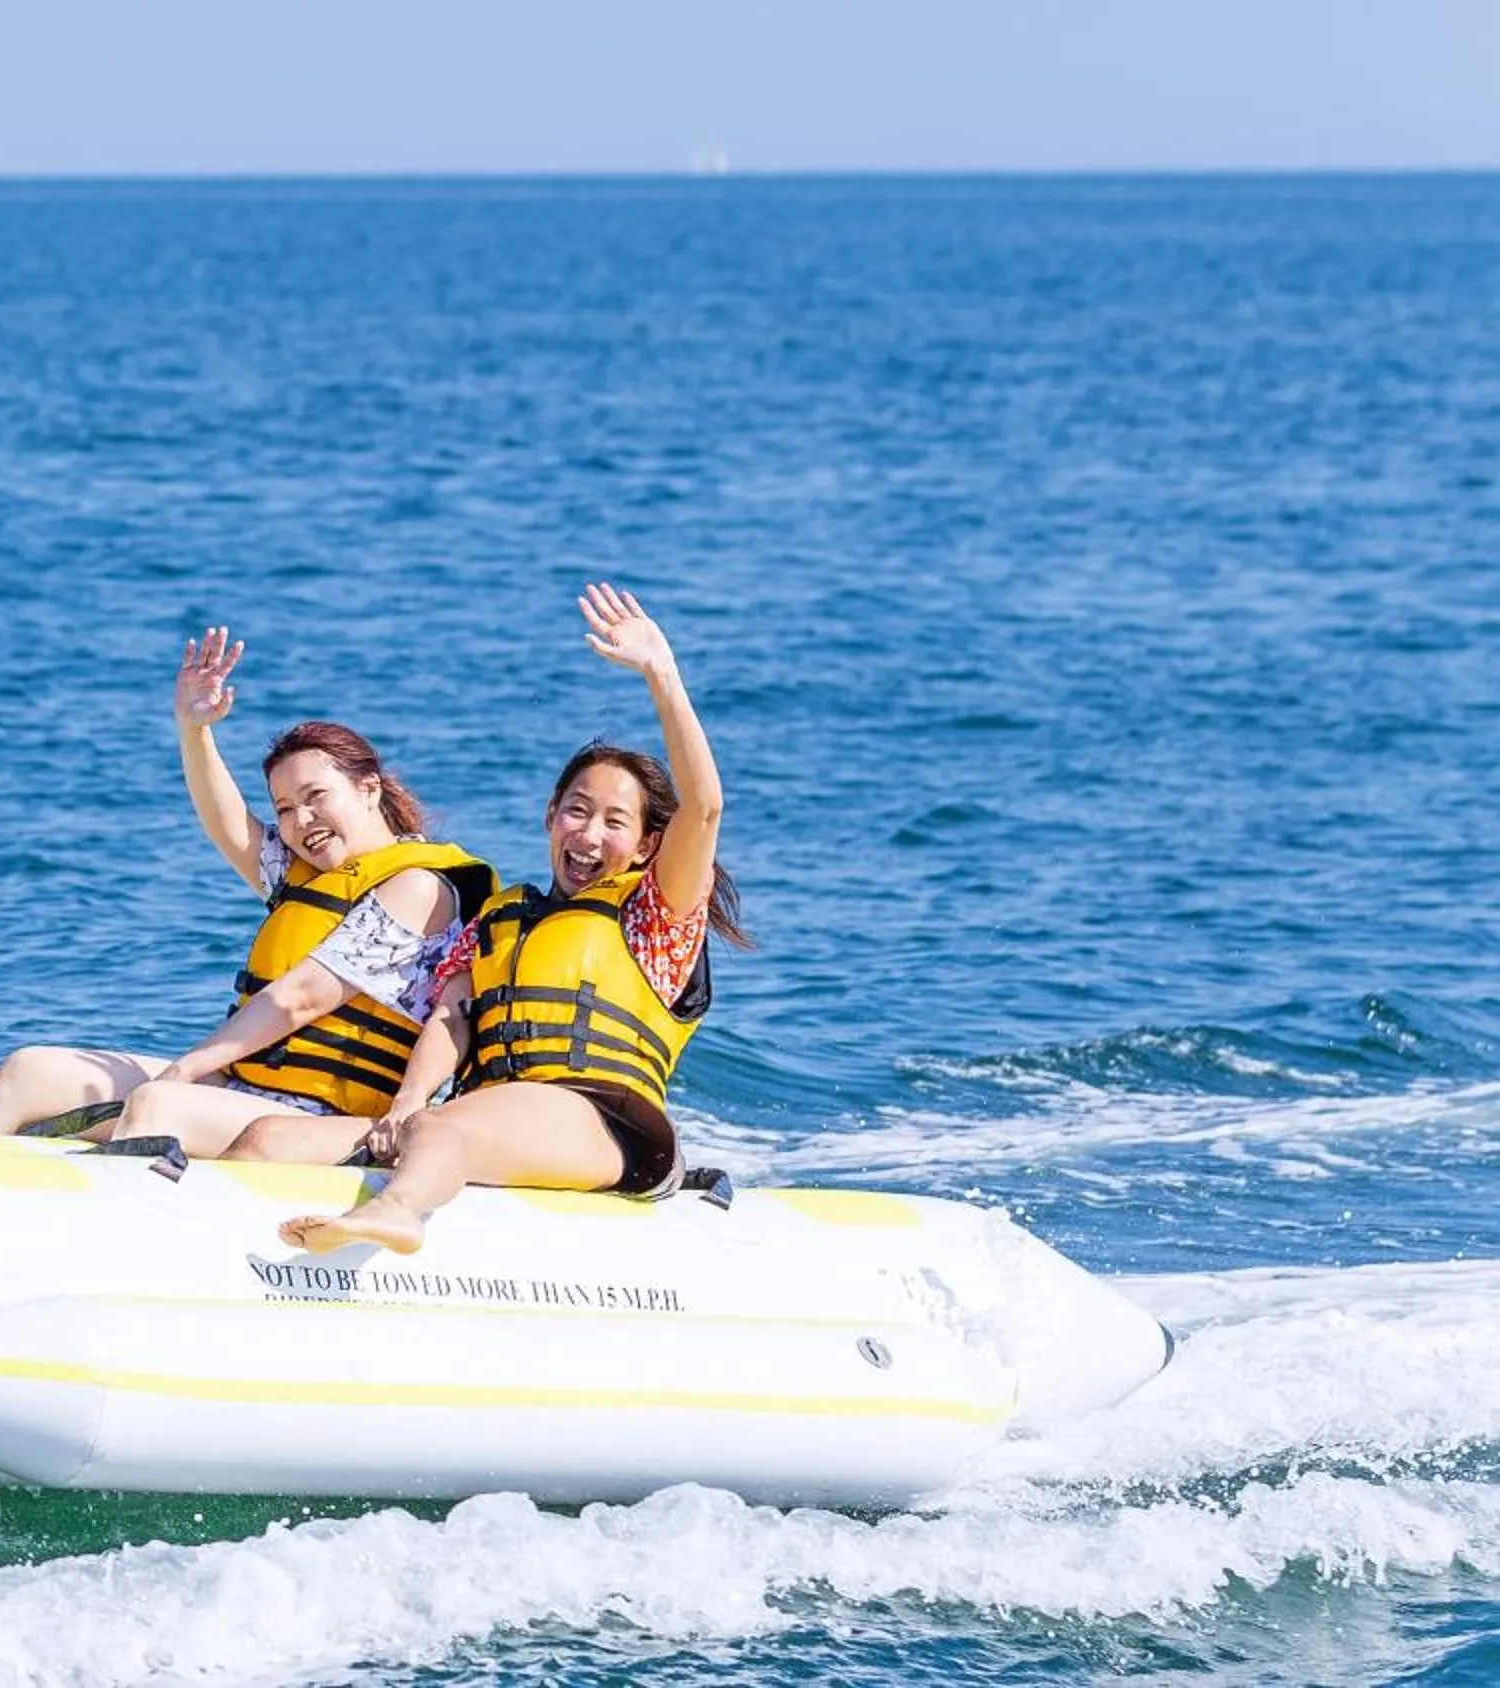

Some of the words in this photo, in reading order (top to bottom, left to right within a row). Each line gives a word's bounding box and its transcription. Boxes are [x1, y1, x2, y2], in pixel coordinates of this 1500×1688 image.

[249, 1263, 295, 1288] NOT
[300, 1265, 331, 1291] TO
[336, 1268, 365, 1292] BE
[368, 1271, 452, 1297] TOWED
[456, 1276, 525, 1302] MORE
[528, 1280, 592, 1305] THAN
[595, 1285, 618, 1308] 15
[622, 1286, 686, 1311] M.P.H.
